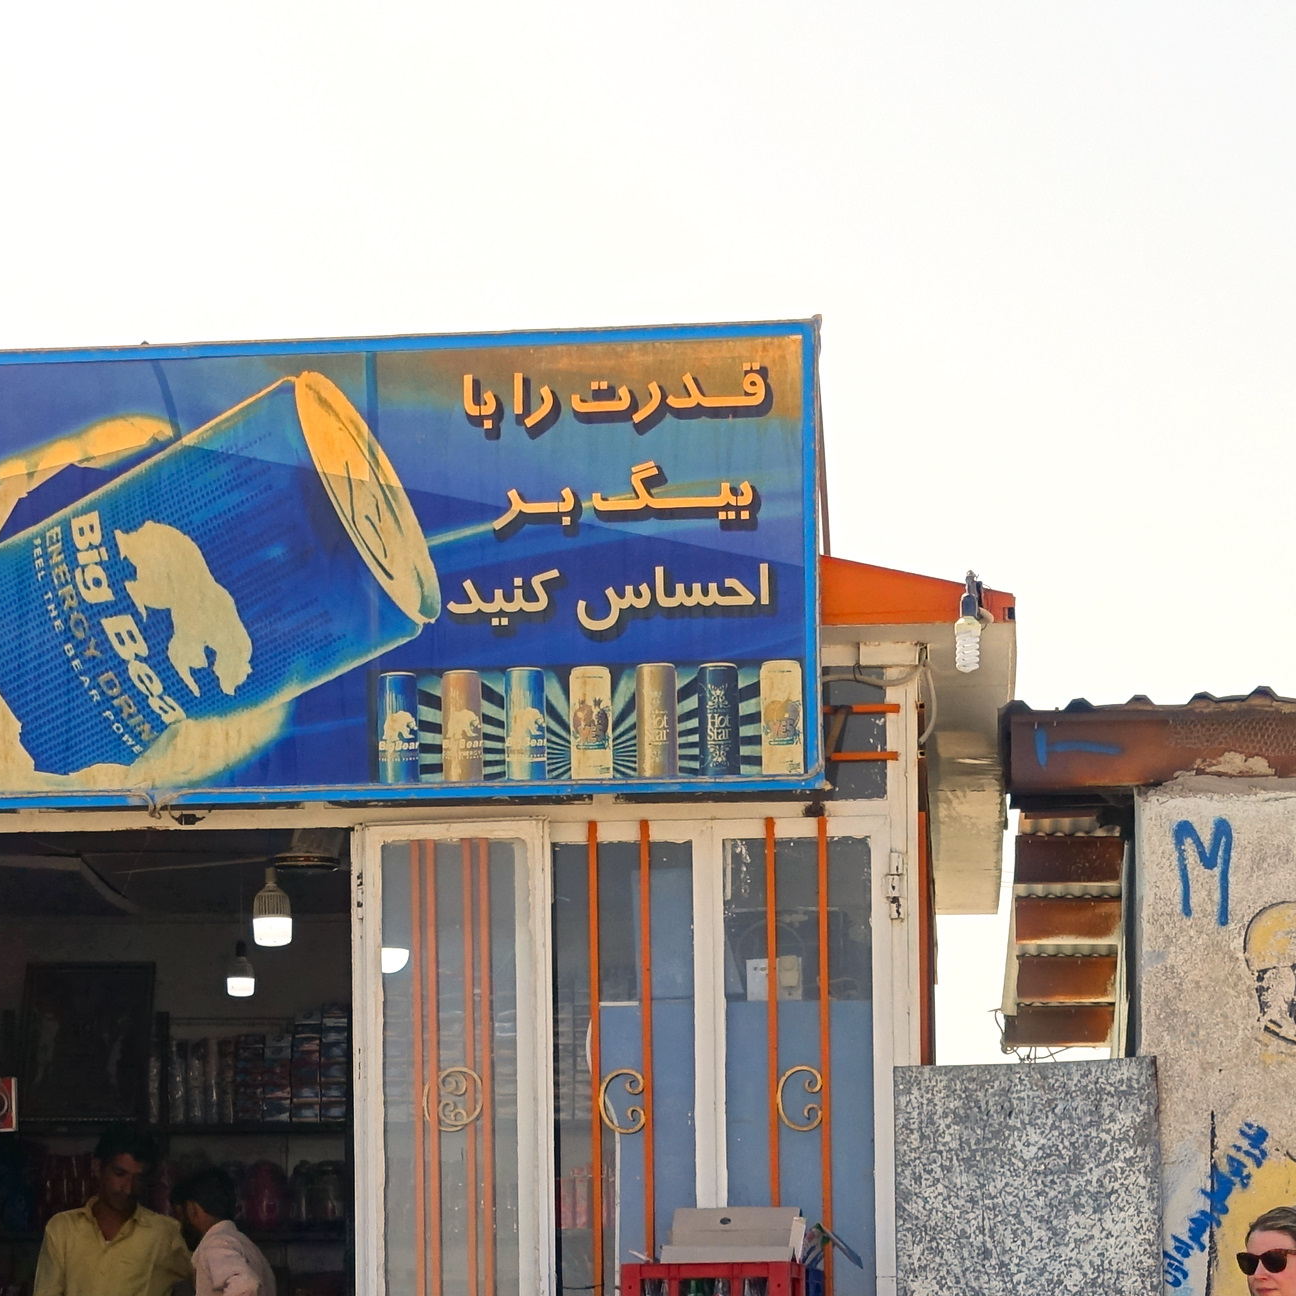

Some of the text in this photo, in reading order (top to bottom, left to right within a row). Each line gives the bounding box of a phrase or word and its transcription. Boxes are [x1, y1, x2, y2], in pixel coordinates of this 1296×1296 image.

[463, 362, 766, 429] قدرت را با
[493, 461, 755, 532] بیگ بر
[446, 563, 770, 631] احساس کنید
[101, 614, 186, 725] Bea
[103, 710, 144, 755] POWE
